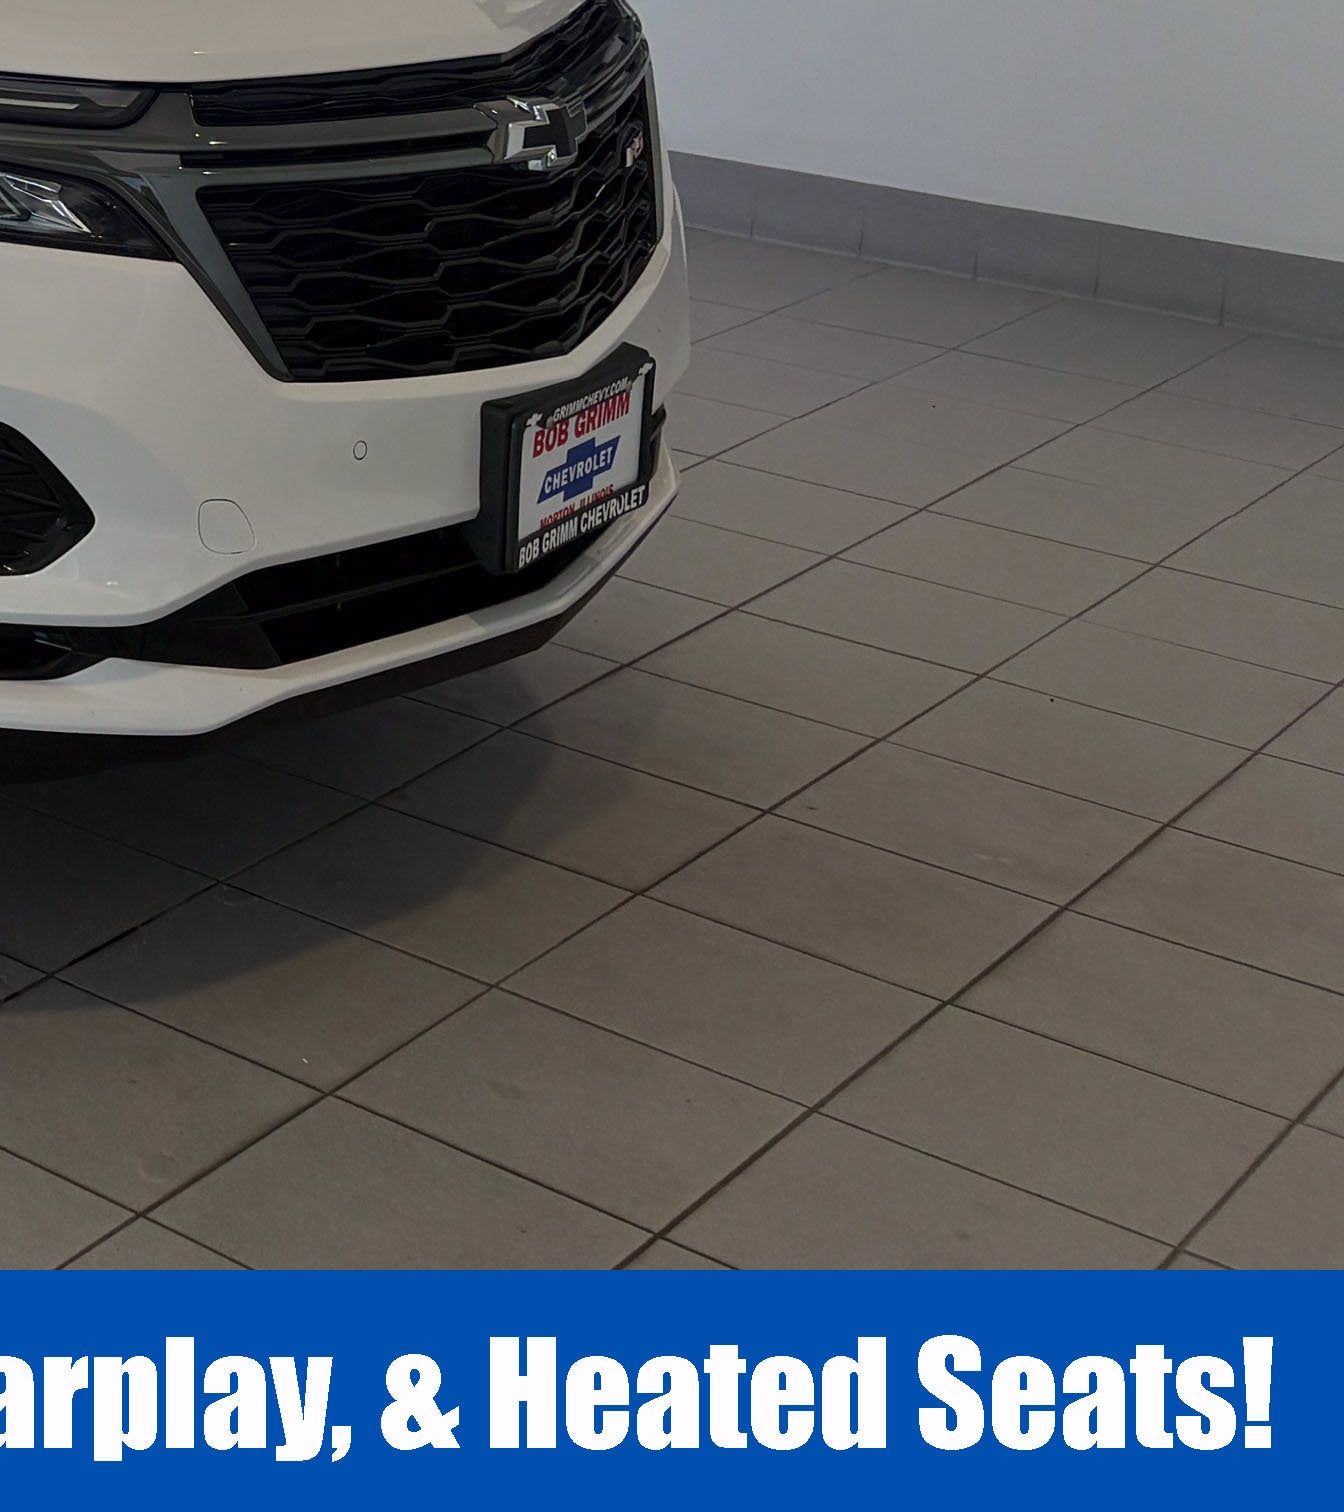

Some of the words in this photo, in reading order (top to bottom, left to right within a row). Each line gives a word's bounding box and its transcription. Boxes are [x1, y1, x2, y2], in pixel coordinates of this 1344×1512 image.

[532, 417, 569, 458] BOB
[574, 391, 632, 439] GRIMM
[552, 376, 629, 423] GRIMMCHEVY.COM
[544, 446, 613, 494] CHEVROLET
[518, 539, 540, 568] BOB
[542, 518, 578, 552] GRIMM
[580, 486, 646, 532] CHEVROLET
